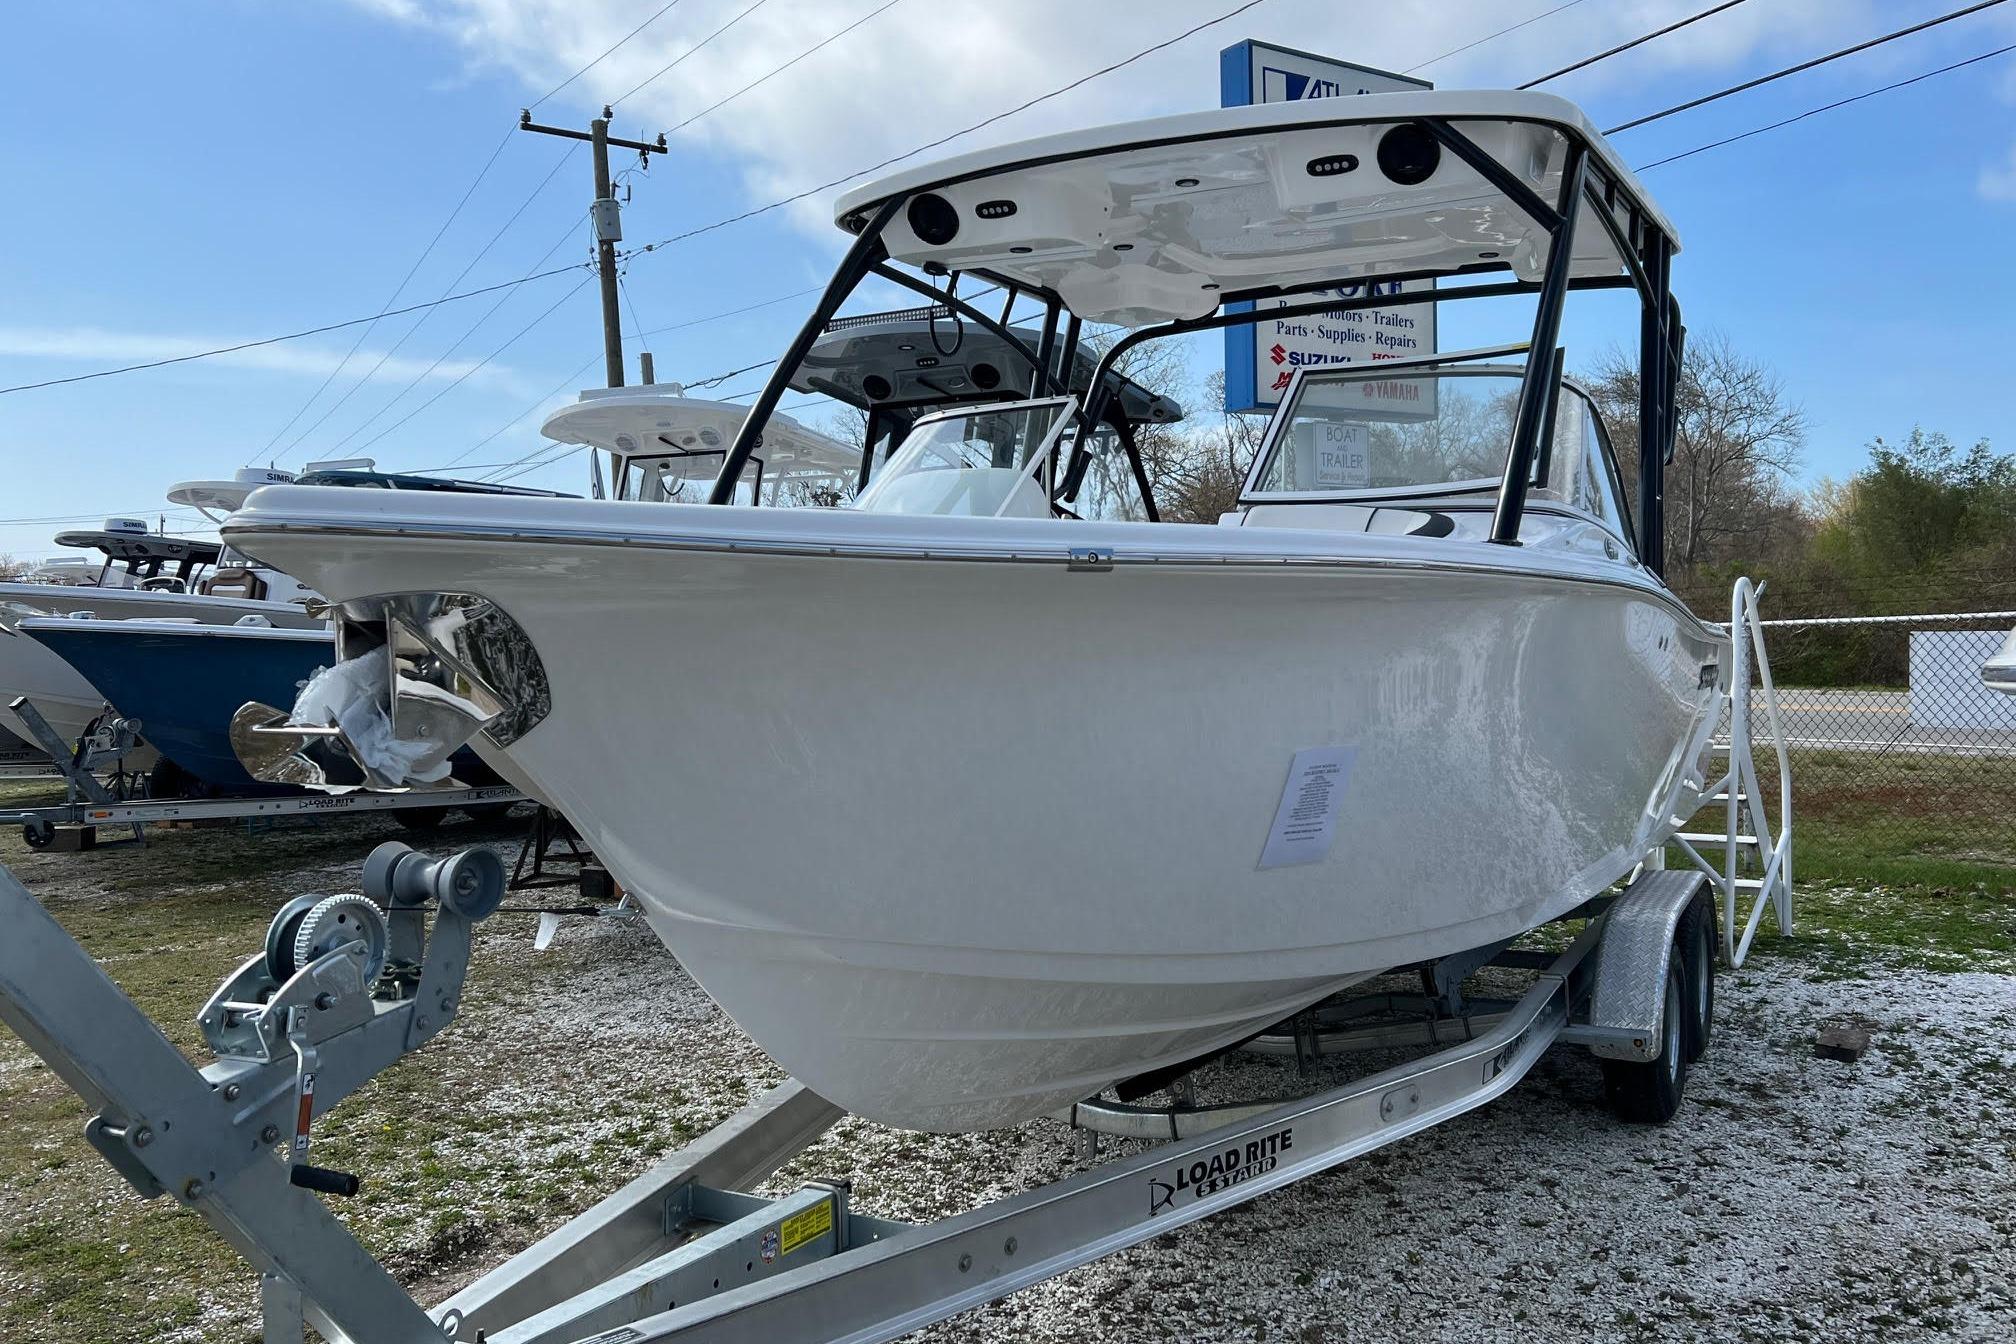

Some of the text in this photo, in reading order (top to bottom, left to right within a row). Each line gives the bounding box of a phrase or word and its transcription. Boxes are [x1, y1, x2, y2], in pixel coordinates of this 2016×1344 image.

[1371, 310, 1415, 329] Trailers
[1276, 320, 1417, 349] Parts Supplies Repairs
[1376, 381, 1419, 401] YAMAHA
[1326, 426, 1358, 443] BOAT
[1320, 452, 1363, 470] TRAILER
[1176, 1128, 1293, 1191] LOAD RITE
